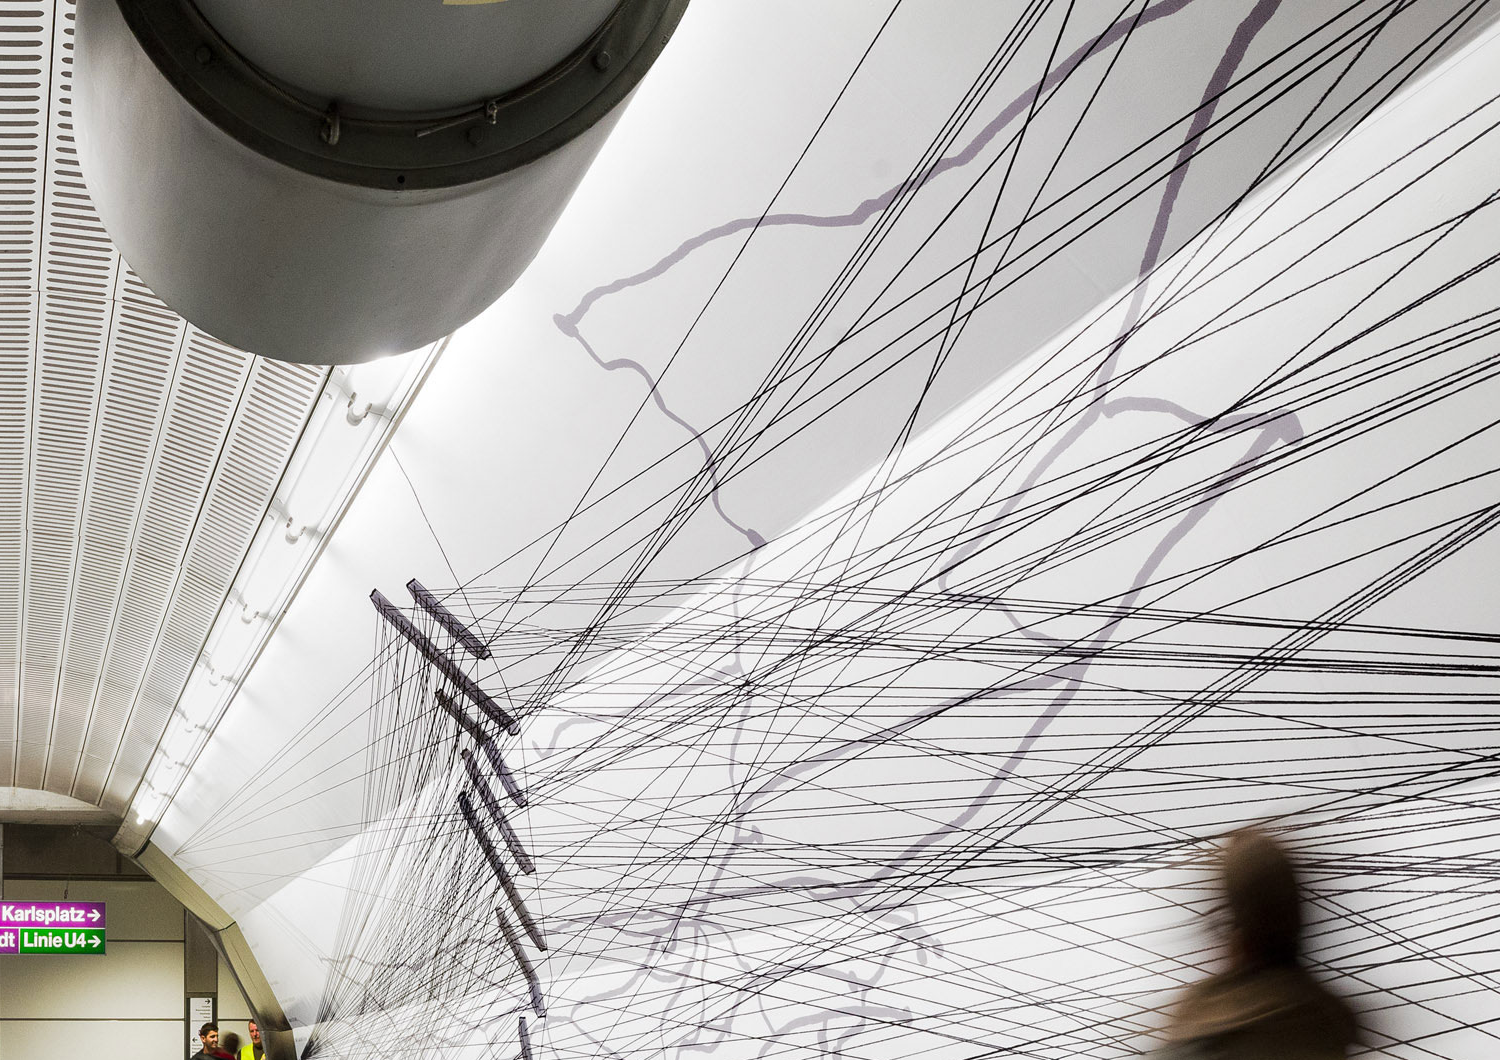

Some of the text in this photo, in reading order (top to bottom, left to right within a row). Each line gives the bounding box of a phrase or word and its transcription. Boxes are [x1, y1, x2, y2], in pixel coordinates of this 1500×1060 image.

[2, 905, 86, 925] Karlsplatz
[23, 932, 87, 947] Linie U4
